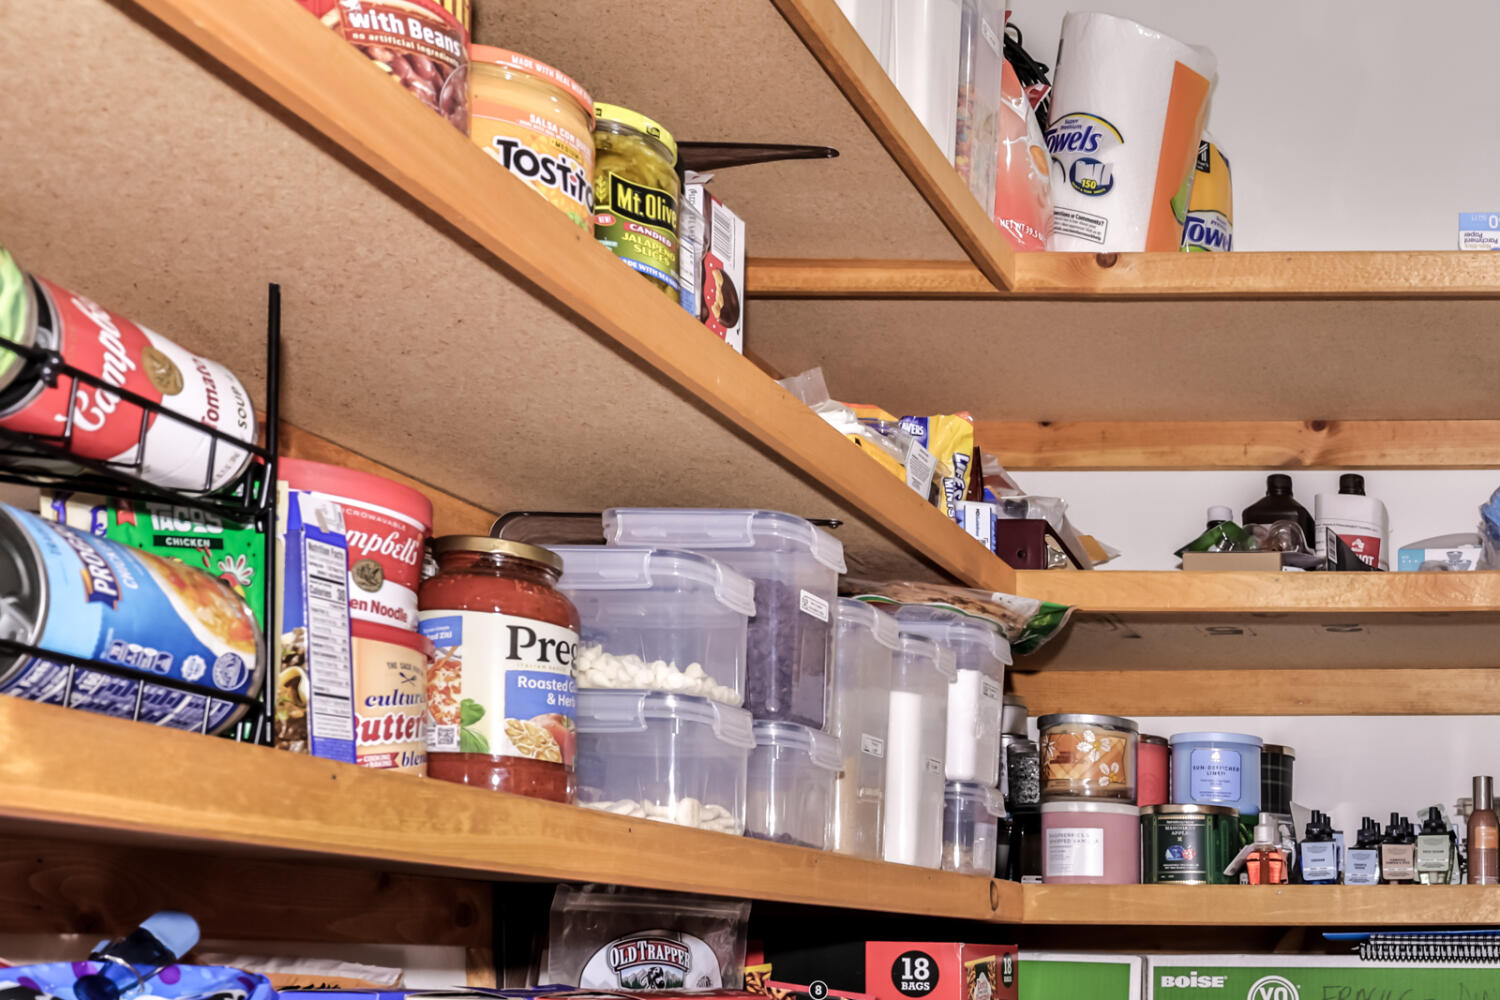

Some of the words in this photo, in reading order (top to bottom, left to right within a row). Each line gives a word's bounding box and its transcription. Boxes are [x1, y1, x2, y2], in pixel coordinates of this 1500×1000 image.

[348, 10, 405, 36] with
[407, 17, 462, 57] Beans
[368, 35, 415, 49] artificial
[511, 55, 533, 69] MADE
[529, 113, 558, 135] SALSA
[1082, 179, 1096, 189] 150
[616, 184, 644, 219] Mt.
[645, 194, 677, 228] Olive
[629, 223, 672, 248] CANDIED
[1464, 237, 1499, 245] Parchment
[633, 244, 670, 267] SLICES
[231, 386, 248, 430] SOUP
[147, 504, 224, 534] TACOS
[165, 537, 211, 548] CHICKEN
[370, 600, 408, 624] Noodle
[517, 675, 568, 692] Roasted
[610, 942, 638, 968] OLD
[637, 939, 691, 969] TRAPPER
[901, 957, 930, 980] 18
[1003, 957, 1013, 975] 18
[814, 985, 822, 995] 8
[901, 982, 931, 991] BAGS
[1161, 971, 1225, 989] BOISE
